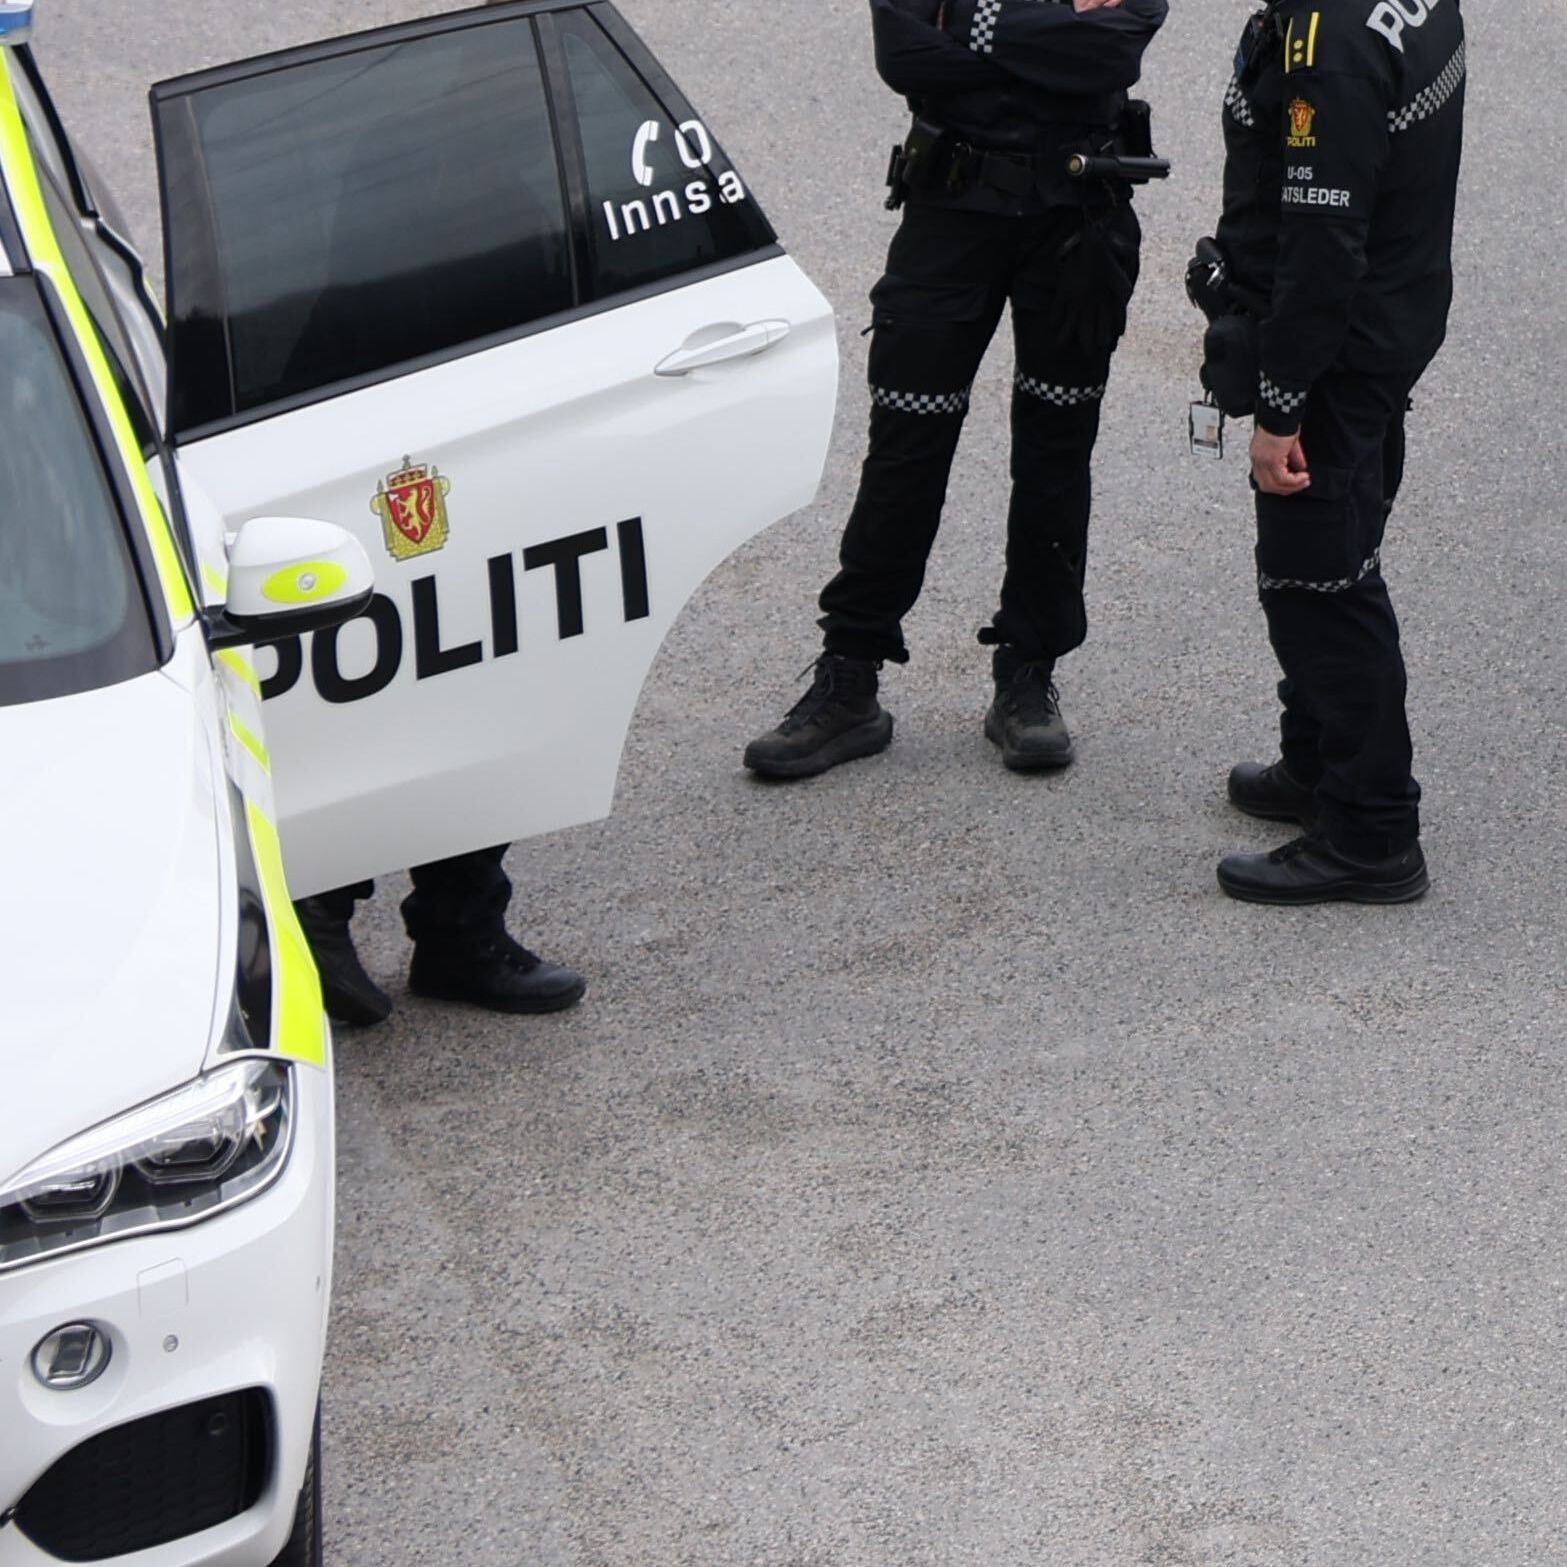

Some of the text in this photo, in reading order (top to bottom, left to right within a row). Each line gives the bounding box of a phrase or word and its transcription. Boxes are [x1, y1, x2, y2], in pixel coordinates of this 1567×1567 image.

[1287, 136, 1316, 147] POLITI
[602, 170, 746, 241] Innsa
[1282, 186, 1351, 208] ATSLEDER
